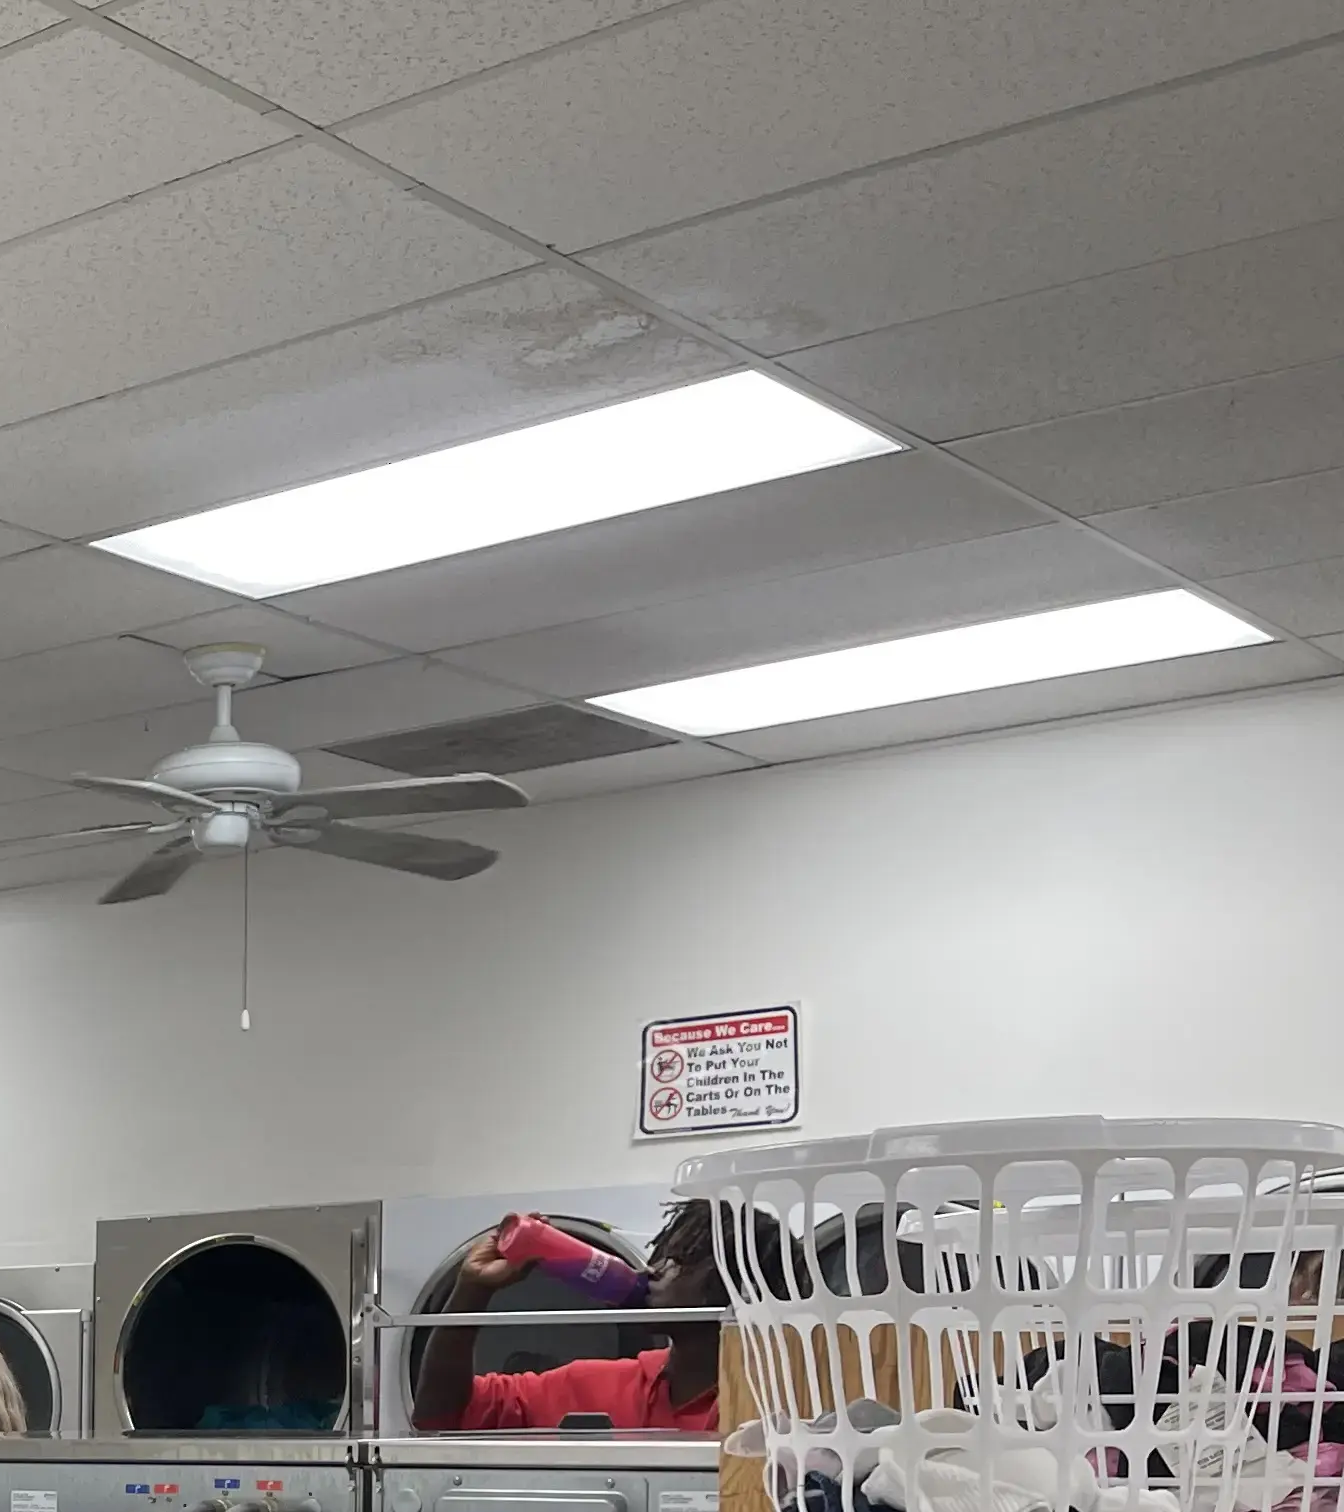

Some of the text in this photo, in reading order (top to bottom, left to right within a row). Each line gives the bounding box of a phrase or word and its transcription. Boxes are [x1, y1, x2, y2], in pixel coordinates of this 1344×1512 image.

[654, 1028, 712, 1043] Because
[716, 1025, 736, 1037] We
[687, 1038, 788, 1058] We Ask You Not
[687, 1058, 760, 1072] To Put Your
[686, 1070, 784, 1088] Children In The
[686, 1084, 790, 1102] Carts Or On The
[686, 1105, 727, 1117] Tables
